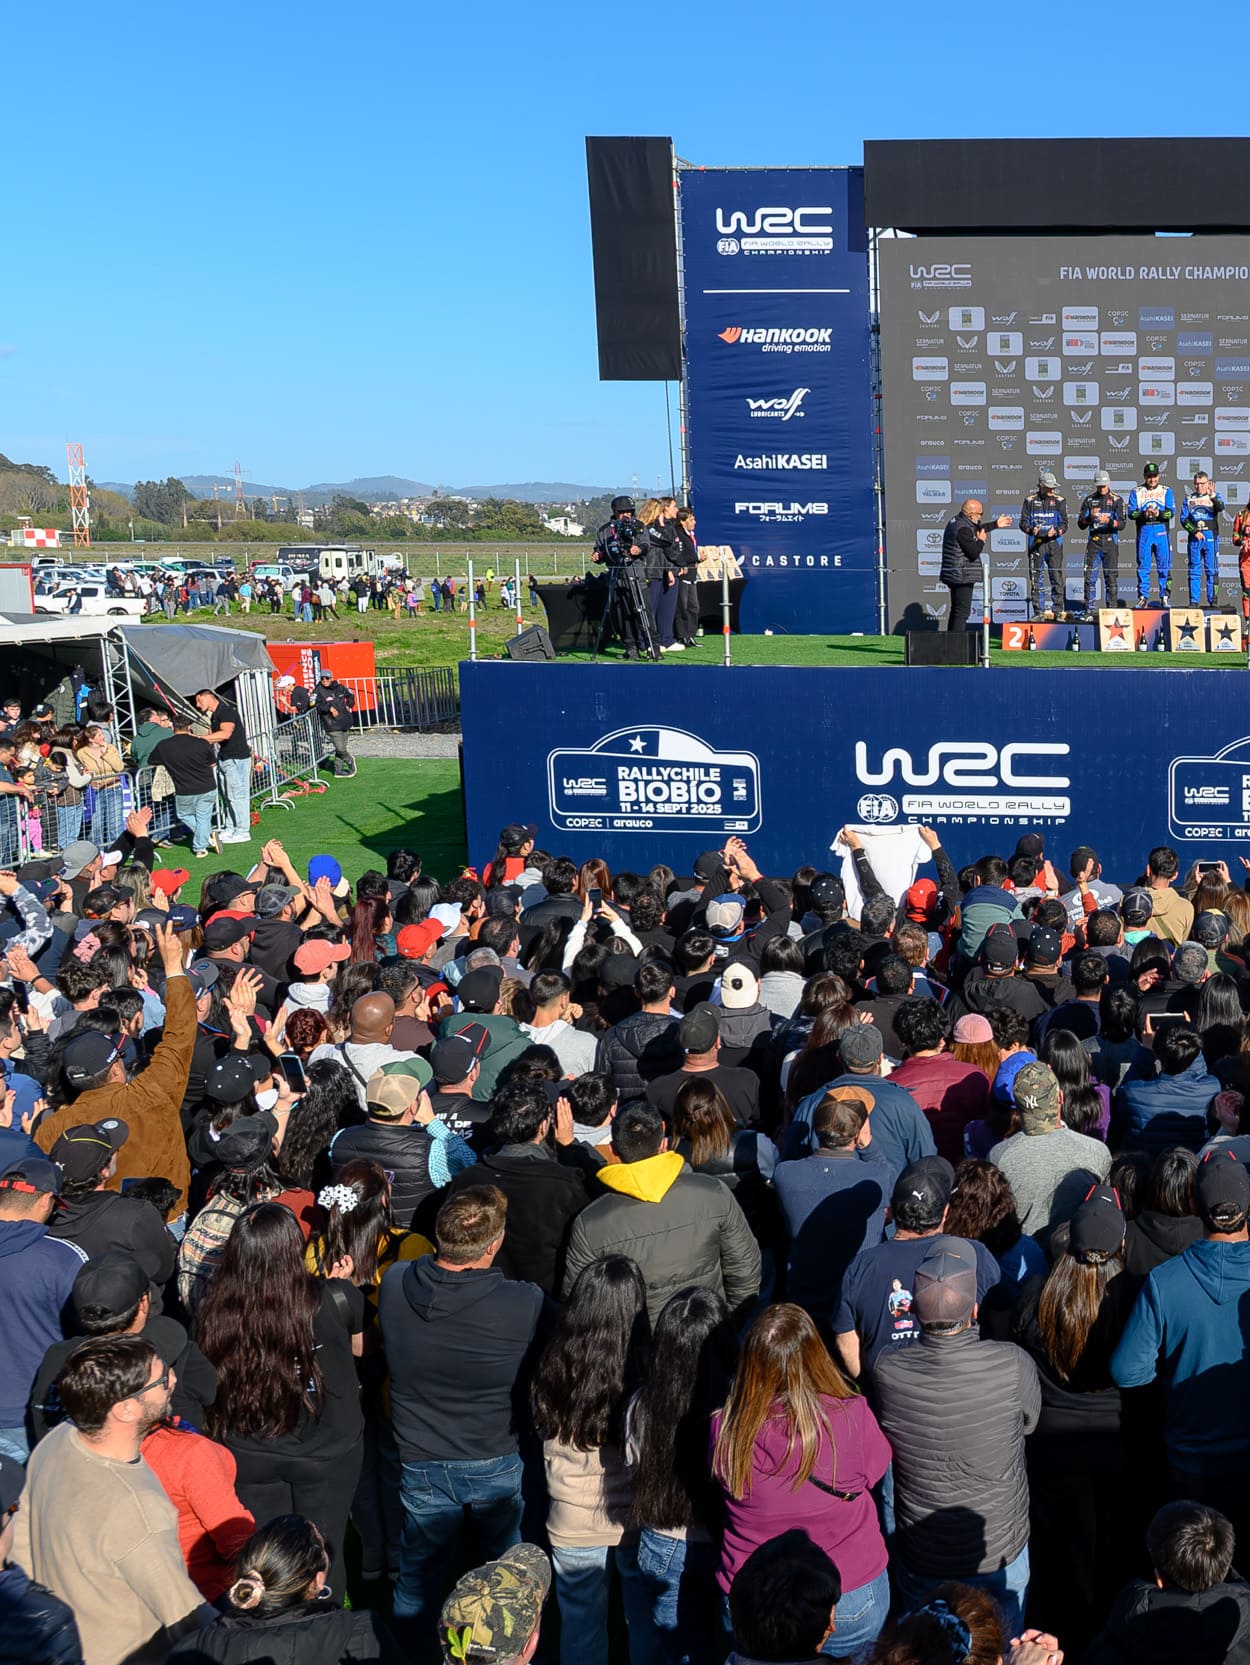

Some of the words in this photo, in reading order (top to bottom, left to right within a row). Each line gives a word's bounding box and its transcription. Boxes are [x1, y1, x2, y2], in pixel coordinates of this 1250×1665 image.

[716, 207, 833, 234] WRC
[910, 264, 971, 278] WRC
[1060, 266, 1082, 280] FIA
[1086, 266, 1135, 280] WORLD
[1140, 266, 1183, 280] RALLY
[762, 344, 792, 354] driving
[794, 344, 831, 352] emotion
[735, 502, 828, 514] FORUM8
[752, 556, 842, 566] CASTORE
[1009, 627, 1023, 648] 2
[855, 740, 1071, 788] WRC
[617, 767, 721, 781] RALLYCHILE
[563, 778, 607, 788] WRC
[1184, 786, 1229, 797] WRC
[620, 803, 631, 812] 11
[640, 803, 655, 812] 14
[656, 803, 689, 813] SEPT
[690, 803, 722, 814] 2025
[908, 800, 932, 809] FIA
[938, 800, 1000, 809] WORLD
[1005, 801, 1065, 810] RALLY
[566, 818, 603, 828] COPEC
[613, 819, 653, 828] arauco
[908, 816, 1066, 825] CHAMPIONSHIP
[1185, 827, 1223, 837] COPEC
